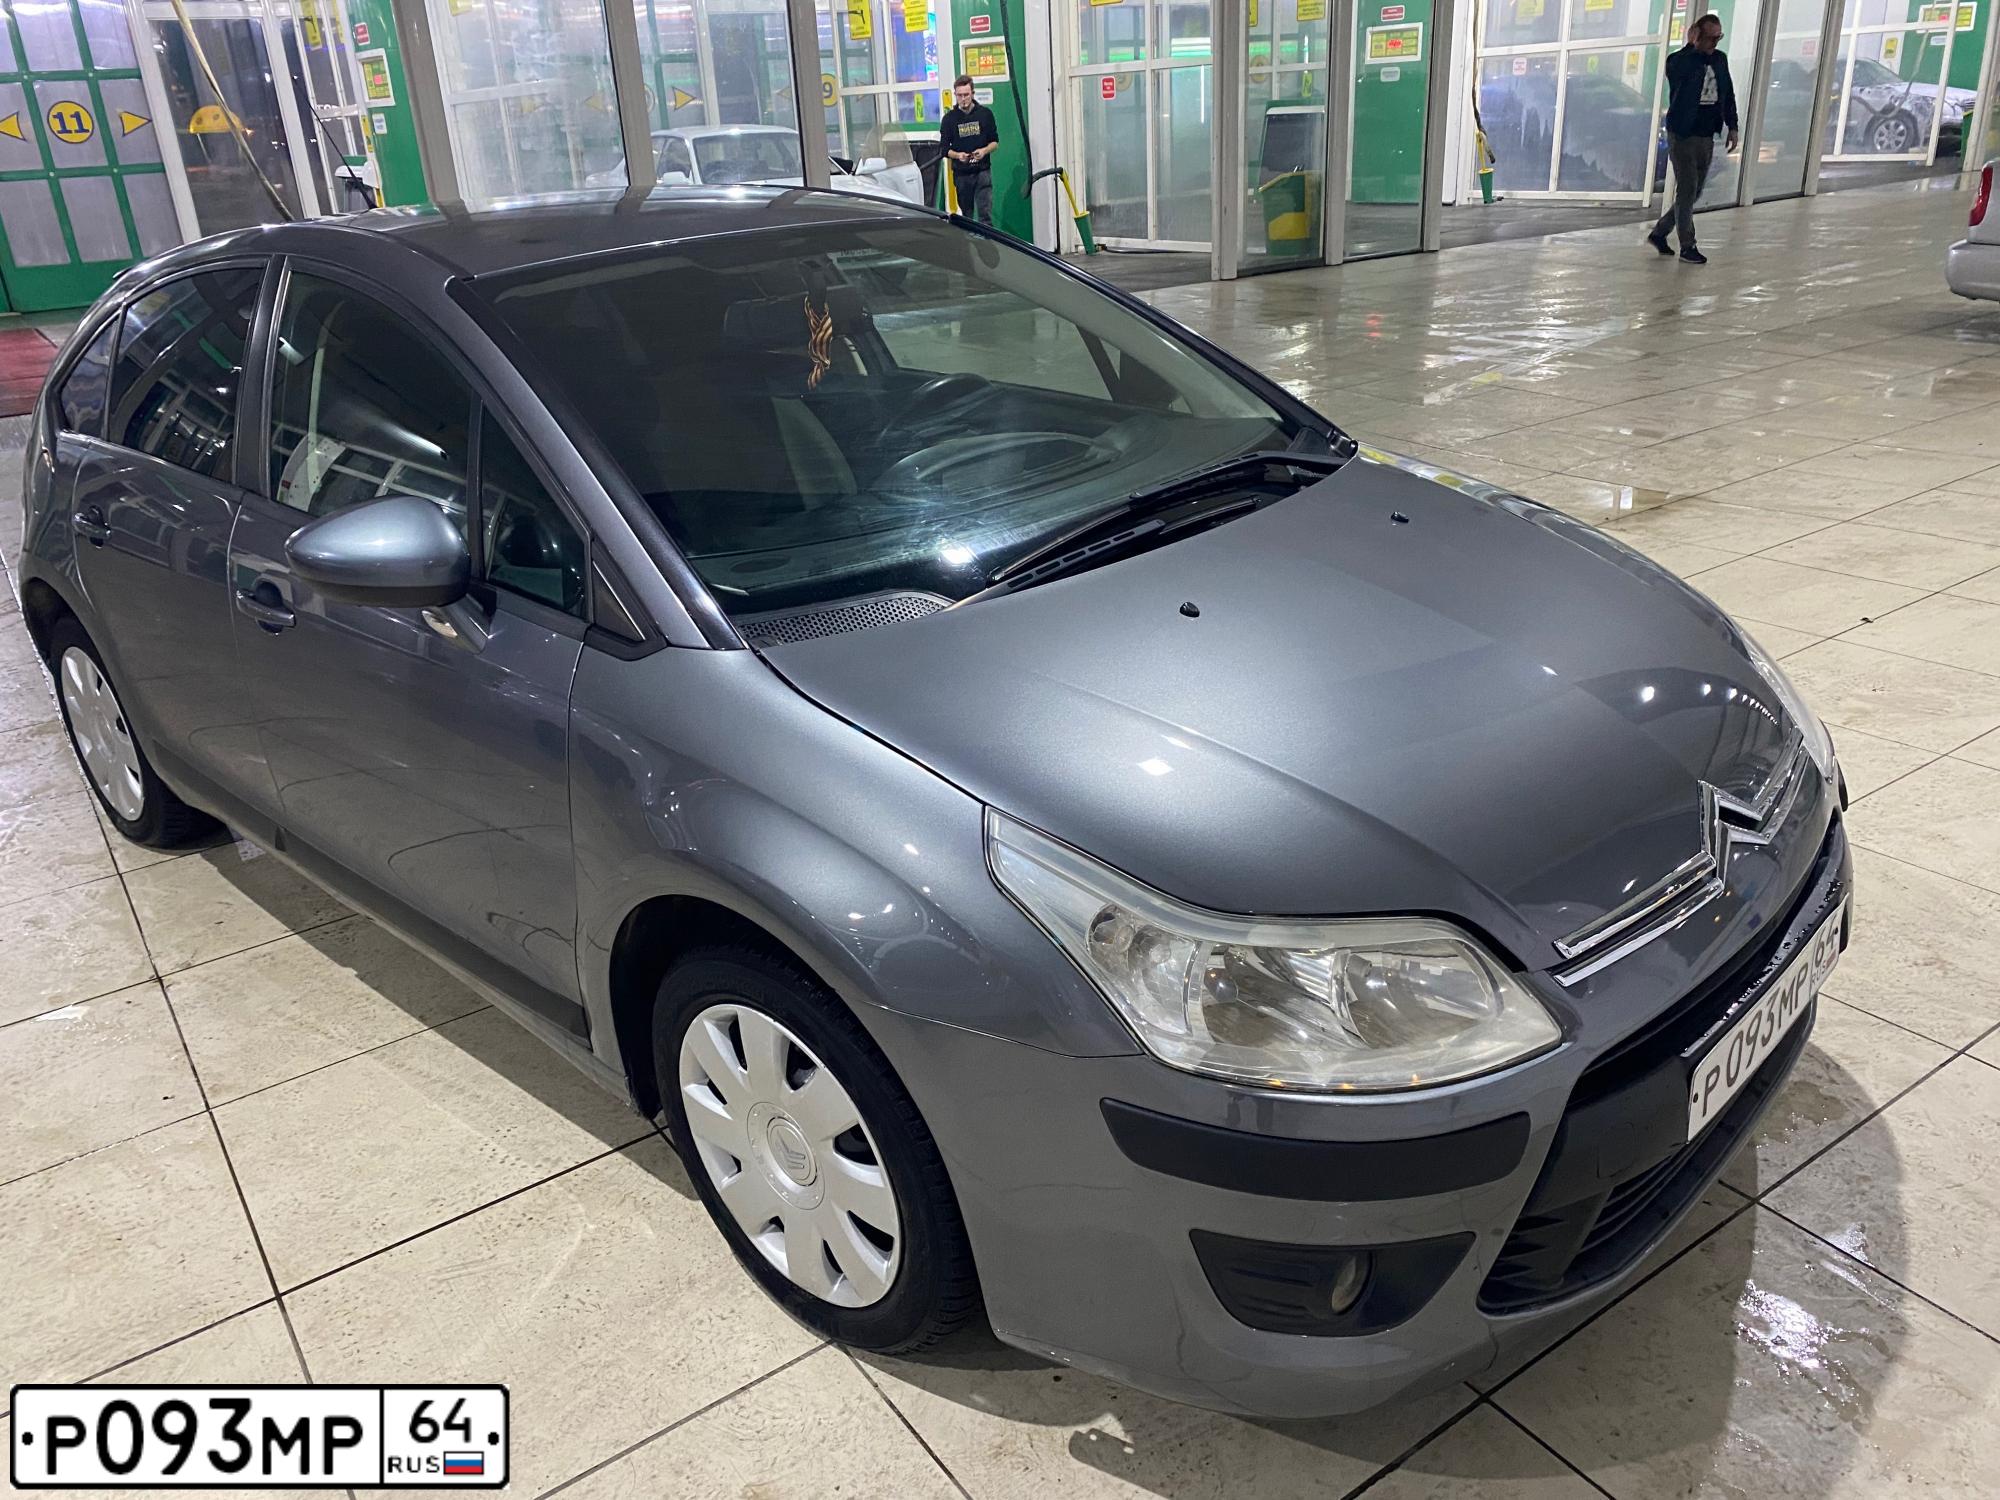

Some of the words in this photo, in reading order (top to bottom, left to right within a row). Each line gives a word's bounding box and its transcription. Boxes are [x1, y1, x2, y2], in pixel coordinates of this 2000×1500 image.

[822, 81, 833, 99] 9
[52, 111, 90, 134] 11
[1811, 960, 1826, 985] RUS
[1702, 961, 1808, 1118] P093MP
[1814, 914, 1837, 968] 64
